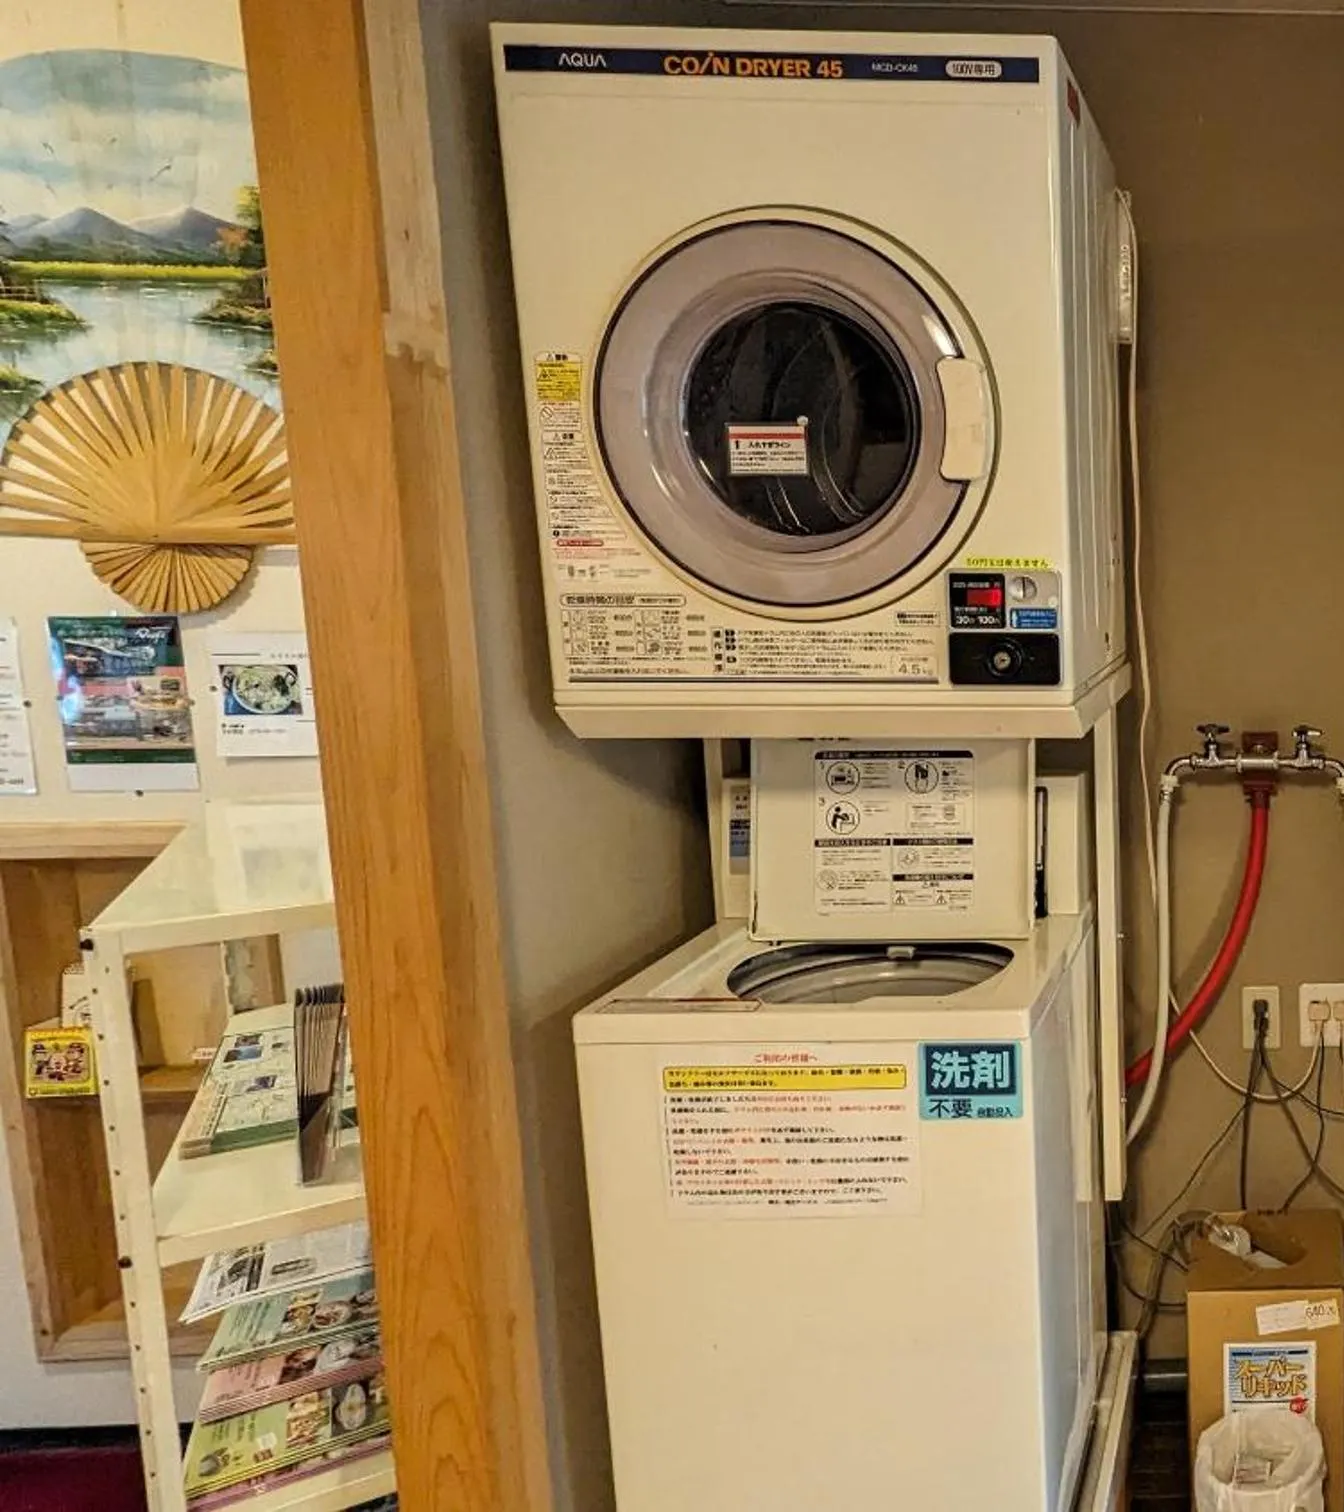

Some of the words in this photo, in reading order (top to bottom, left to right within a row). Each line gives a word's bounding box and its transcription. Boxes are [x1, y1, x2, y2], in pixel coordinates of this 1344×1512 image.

[558, 53, 607, 68] AQUA
[664, 52, 730, 75] COIN
[735, 58, 811, 78] DRYER
[816, 60, 844, 79] 45
[930, 1050, 1010, 1090] 洗剤
[928, 1098, 973, 1119] 不要
[1234, 1357, 1305, 1378] スーパー
[1240, 1374, 1308, 1399] リキッド
